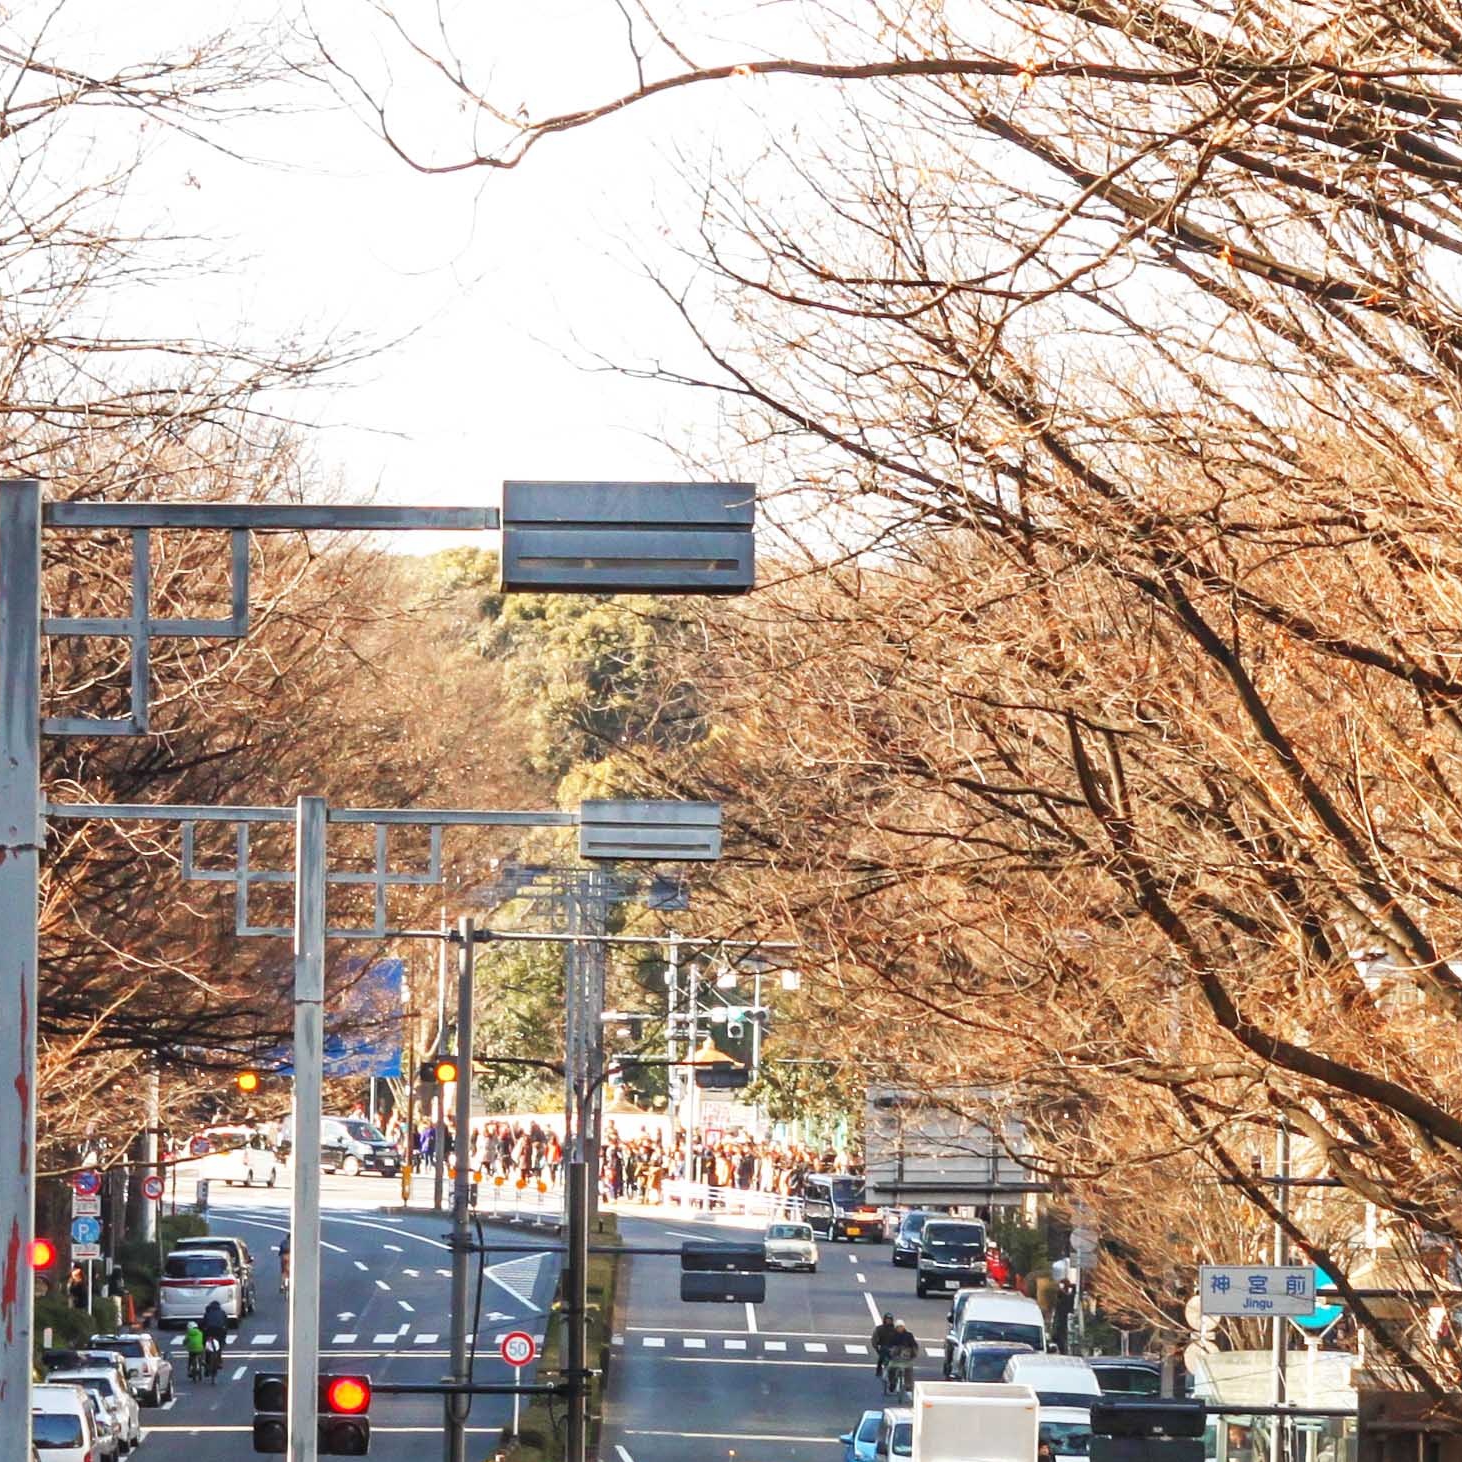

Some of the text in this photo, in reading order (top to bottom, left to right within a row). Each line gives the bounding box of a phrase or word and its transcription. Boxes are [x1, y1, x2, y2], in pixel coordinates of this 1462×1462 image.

[1211, 1274, 1306, 1296] 神宮前
[1243, 1298, 1273, 1311] Jingu
[509, 1341, 528, 1357] 50
